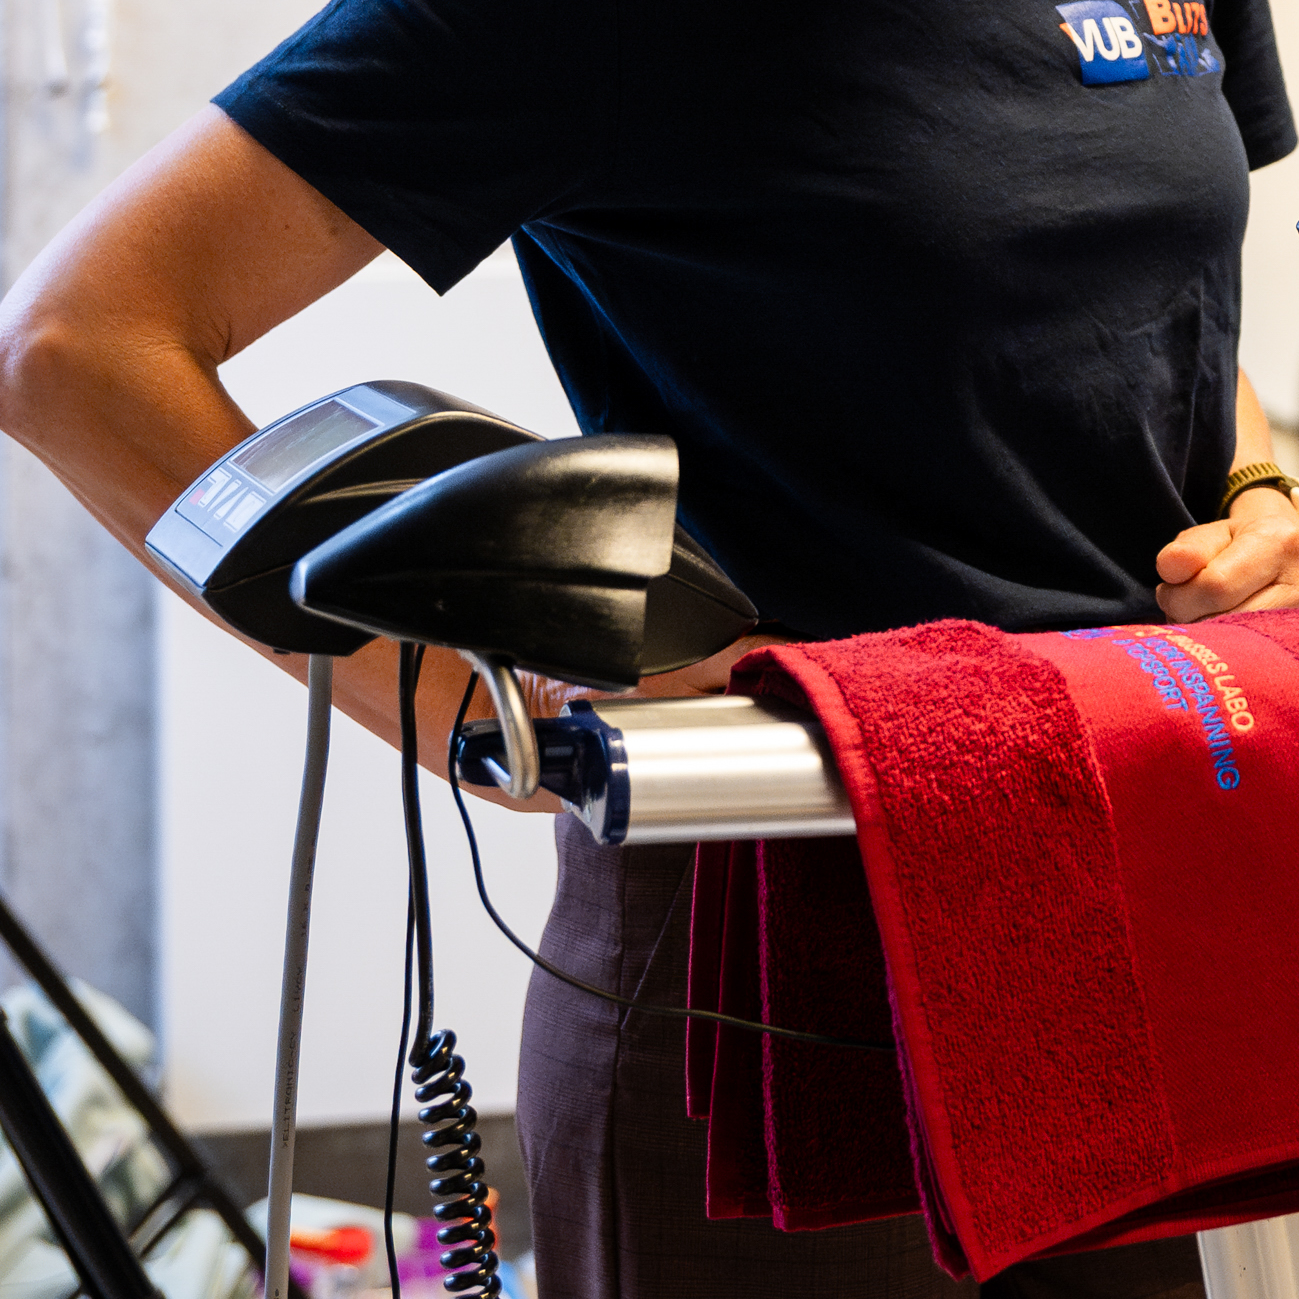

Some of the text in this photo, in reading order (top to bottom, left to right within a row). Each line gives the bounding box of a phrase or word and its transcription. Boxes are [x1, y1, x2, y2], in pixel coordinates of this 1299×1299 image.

[1066, 16, 1143, 62] VUB
[1169, 659, 1241, 791] INSPANNING
[1214, 674, 1255, 732] LABO
